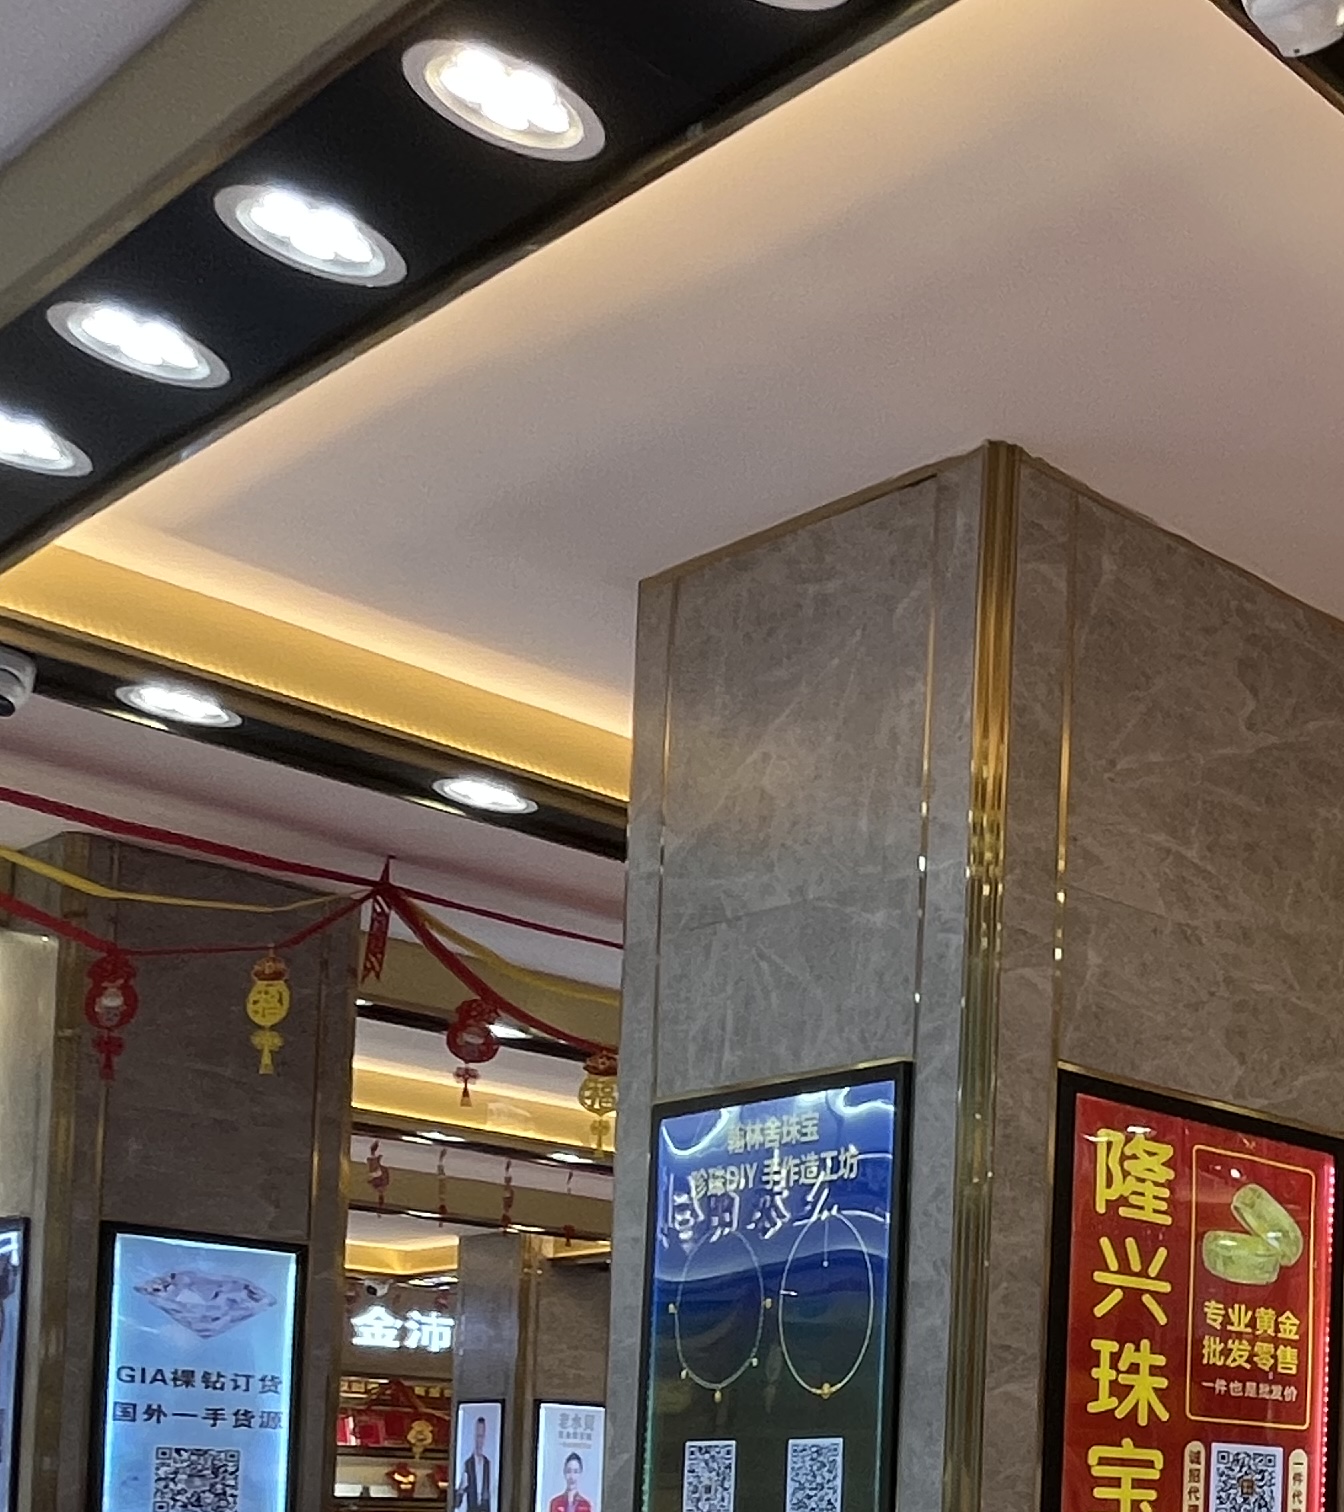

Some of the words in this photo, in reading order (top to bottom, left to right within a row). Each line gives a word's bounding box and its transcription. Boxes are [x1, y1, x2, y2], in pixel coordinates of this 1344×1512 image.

[1203, 1300, 1300, 1340] 专业黄金
[1202, 1335, 1298, 1375] 批发零售
[112, 1401, 284, 1430] 国外一手货源
